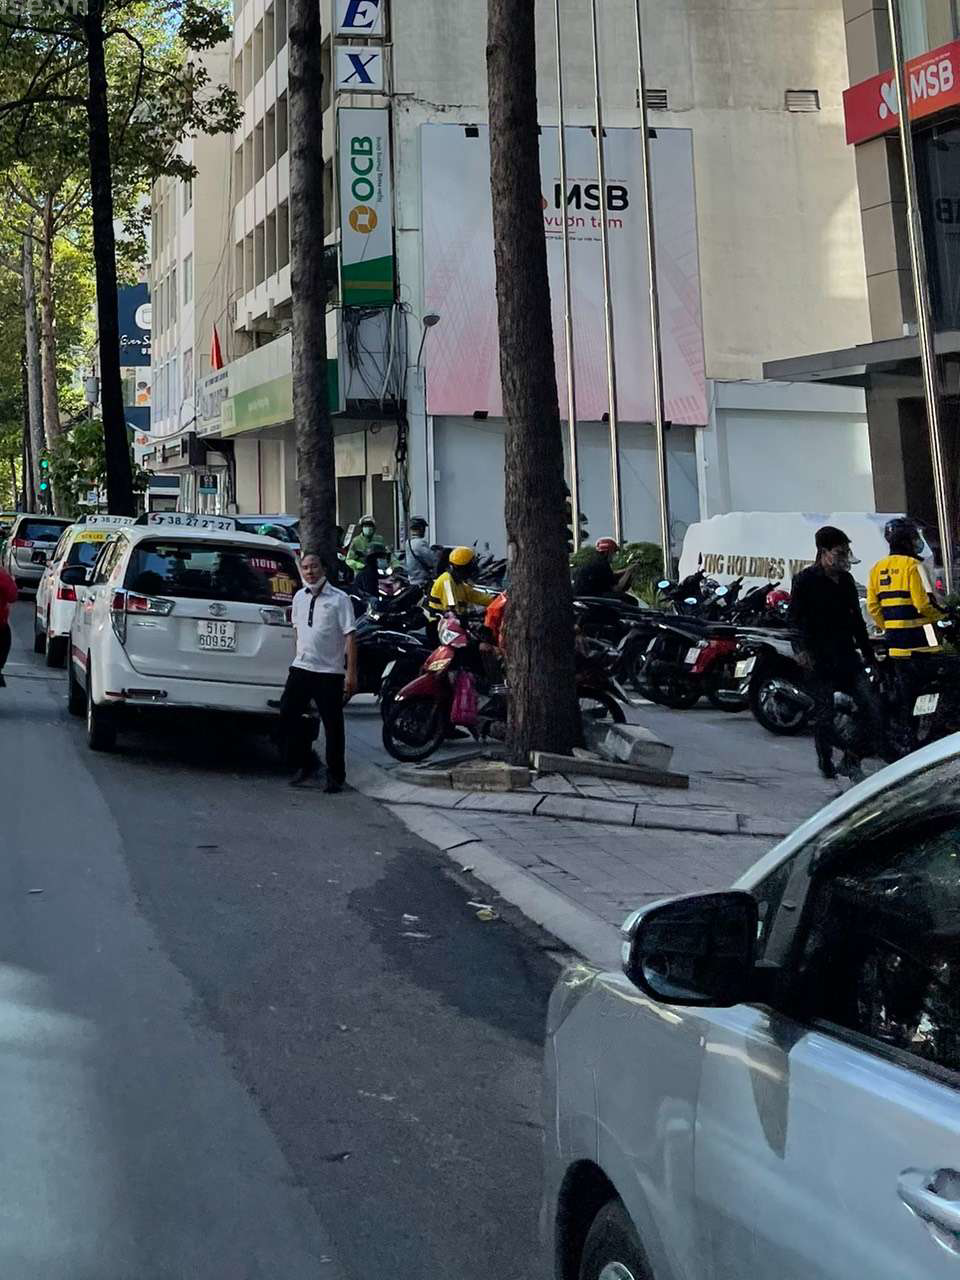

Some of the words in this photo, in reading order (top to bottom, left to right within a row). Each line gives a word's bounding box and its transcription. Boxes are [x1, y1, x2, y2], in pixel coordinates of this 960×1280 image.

[909, 58, 955, 105] MSB
[350, 136, 375, 202] OCB
[554, 183, 629, 211] MSB
